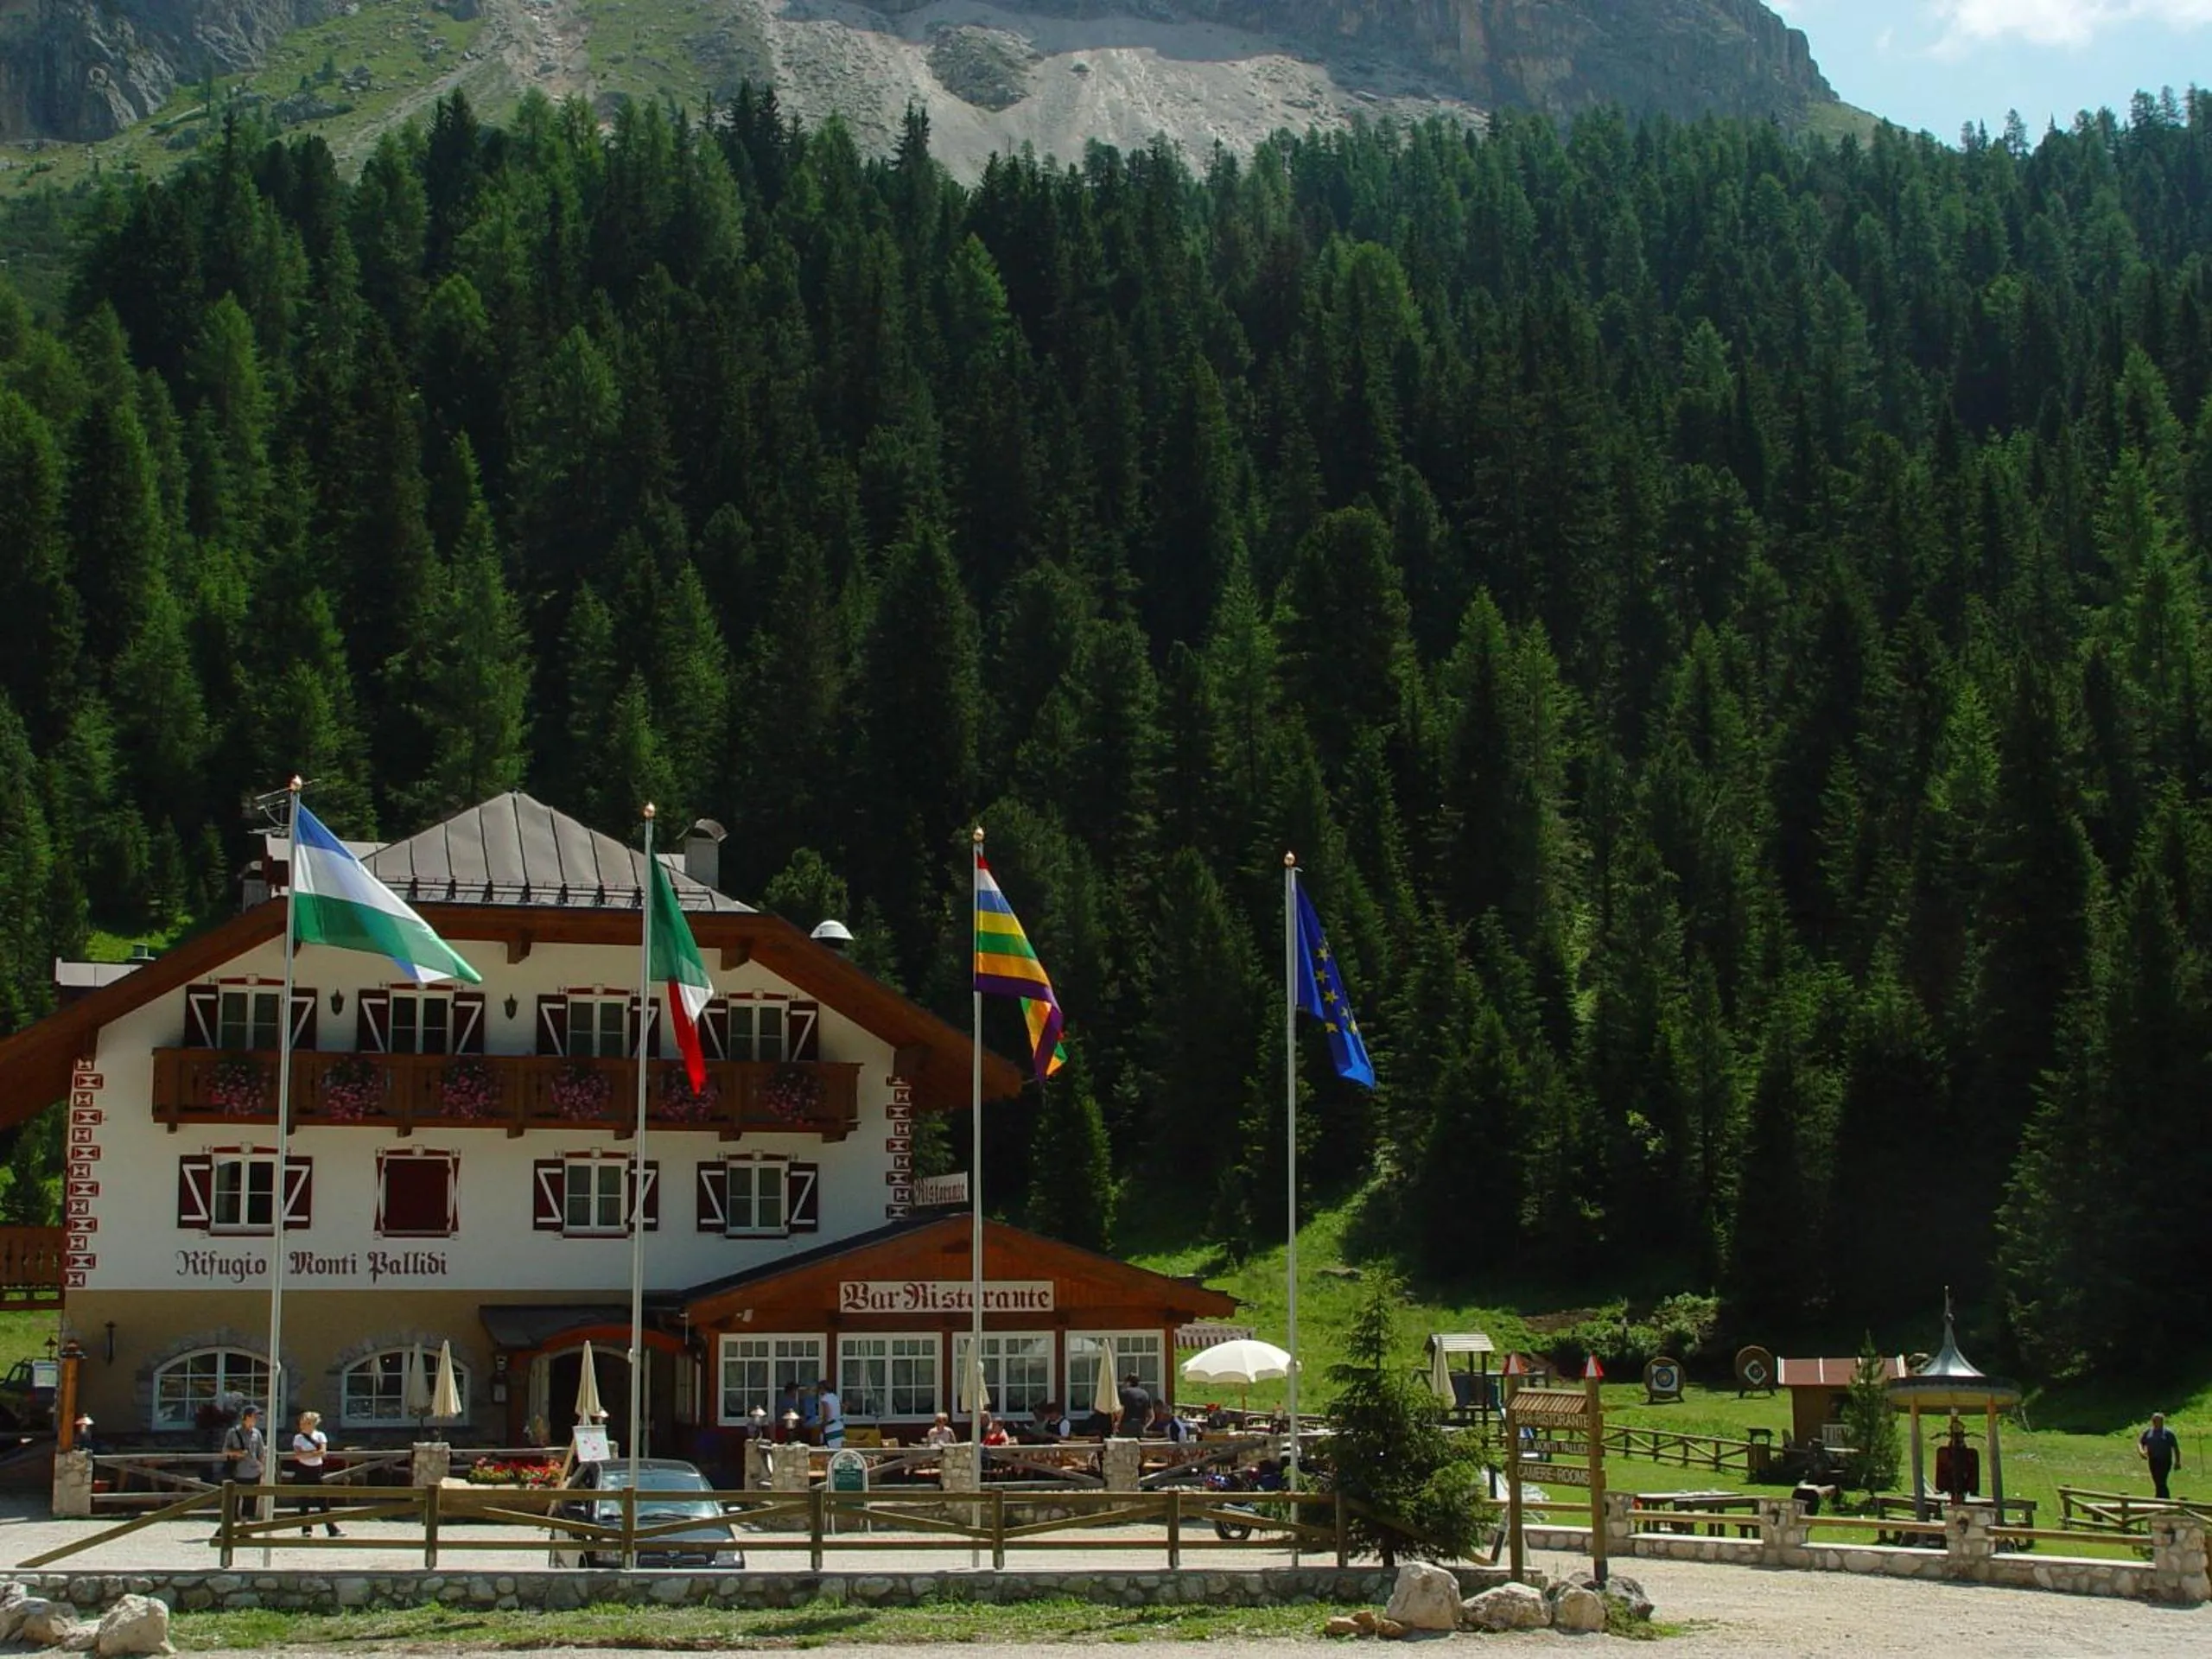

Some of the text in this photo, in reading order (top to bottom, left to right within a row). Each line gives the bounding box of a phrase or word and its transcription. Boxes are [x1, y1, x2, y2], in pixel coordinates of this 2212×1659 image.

[176, 1250, 448, 1284] Rifugio Monti Pallidi
[843, 1282, 900, 1310] Bar
